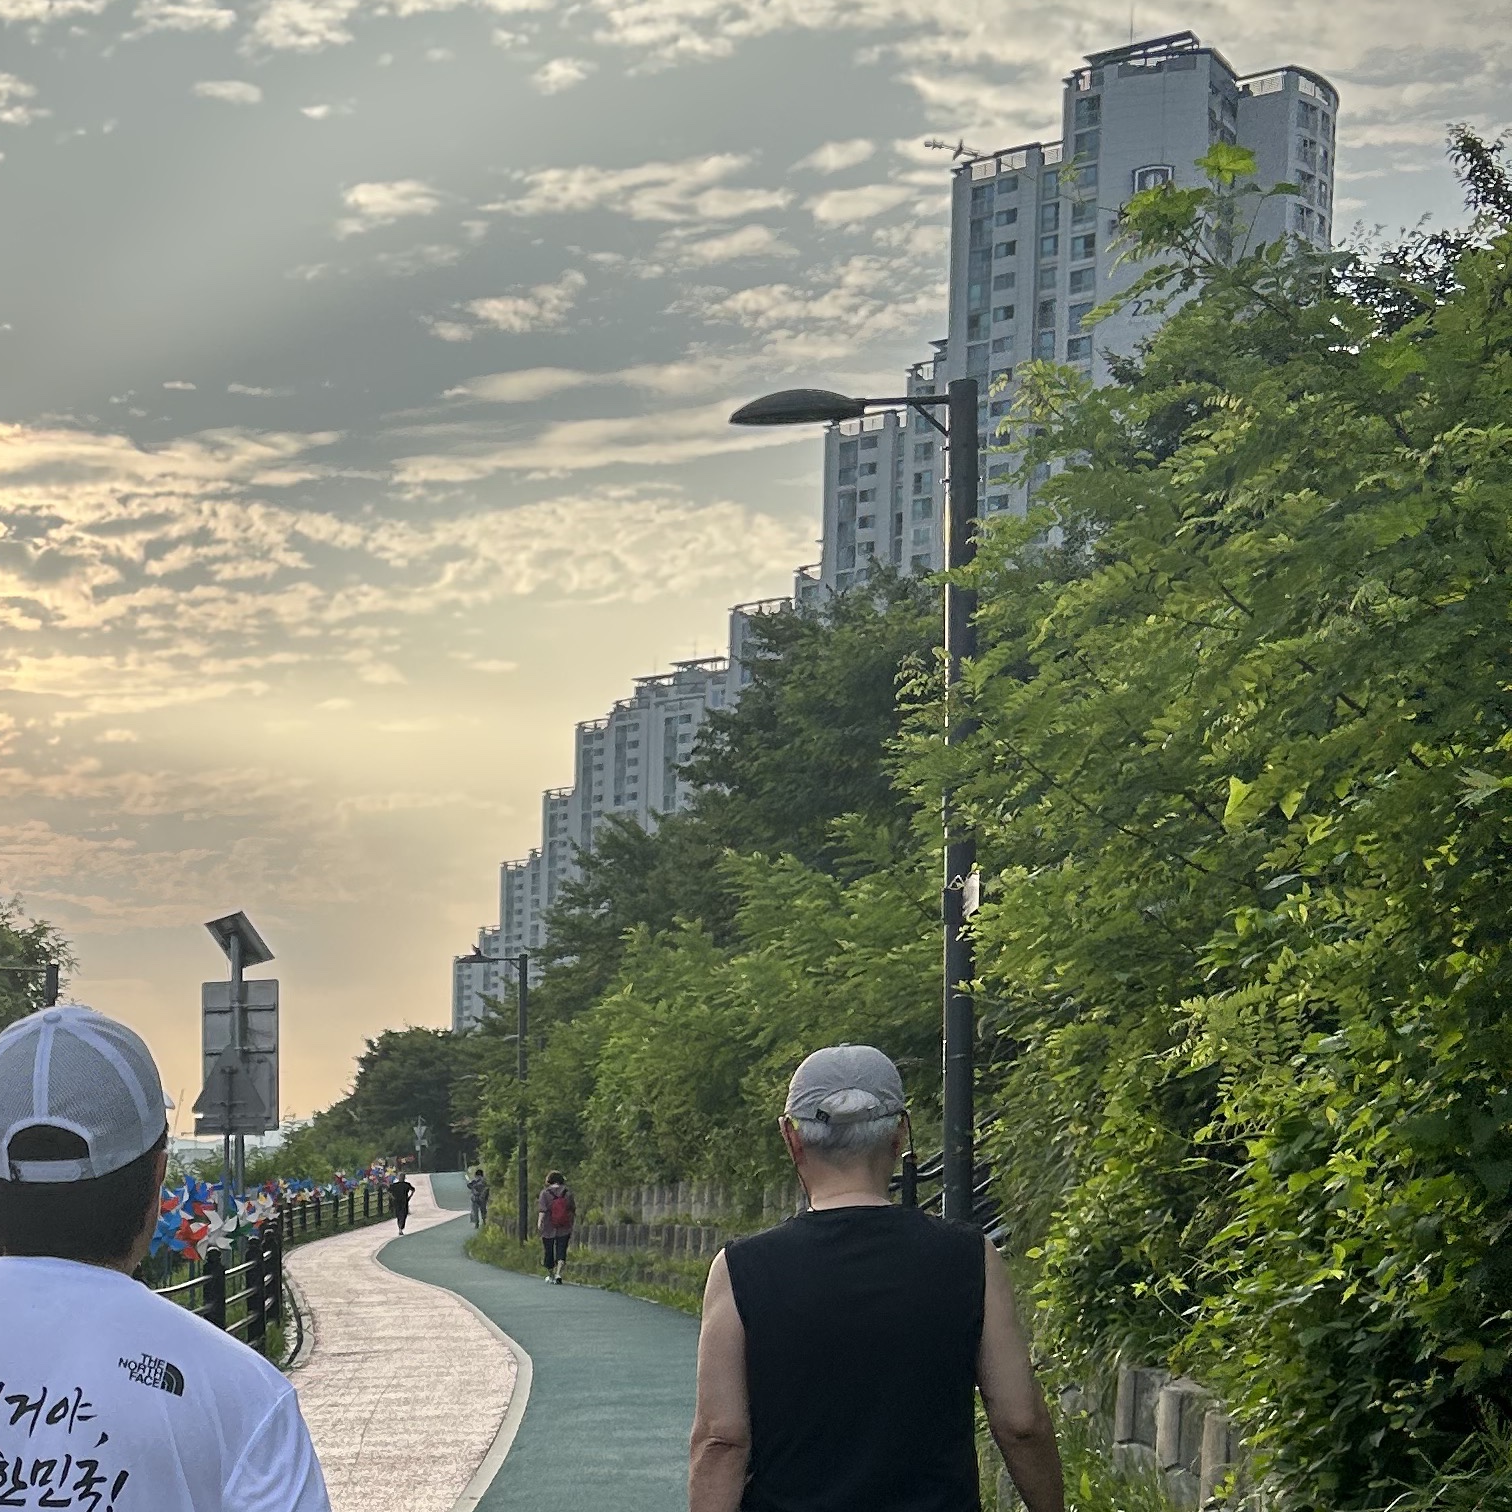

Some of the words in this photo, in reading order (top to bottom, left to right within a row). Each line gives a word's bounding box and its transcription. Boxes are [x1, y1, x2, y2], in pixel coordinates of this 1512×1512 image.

[117, 1357, 164, 1381] NORTH
[141, 1352, 166, 1369] THE
[128, 1370, 161, 1389] FACE
